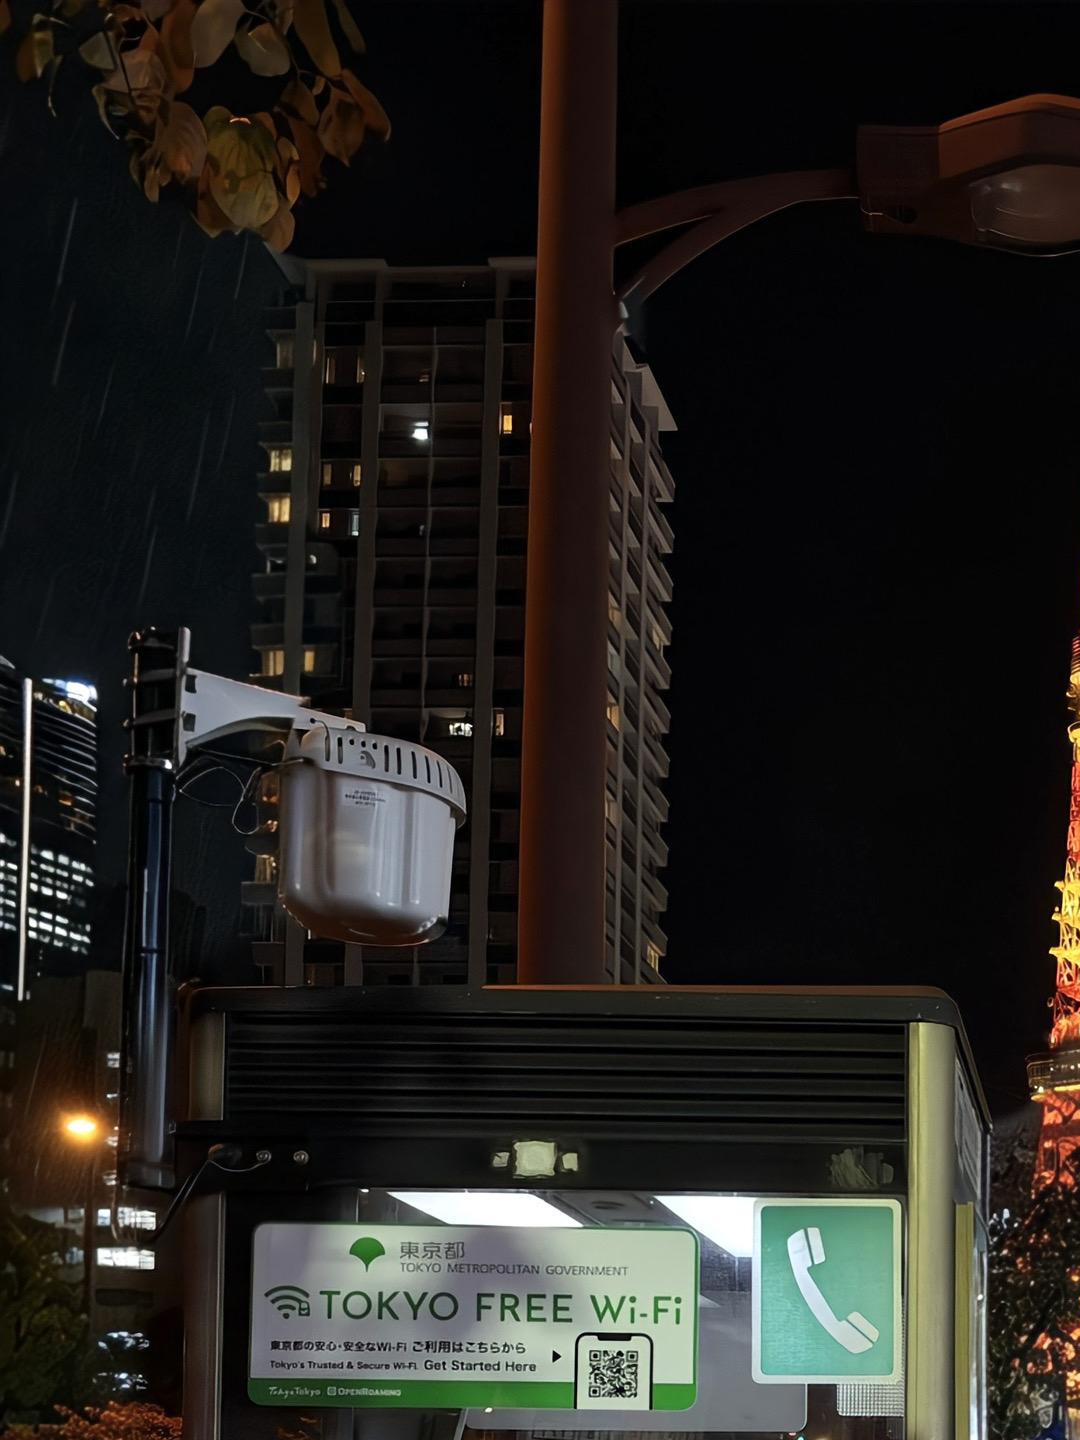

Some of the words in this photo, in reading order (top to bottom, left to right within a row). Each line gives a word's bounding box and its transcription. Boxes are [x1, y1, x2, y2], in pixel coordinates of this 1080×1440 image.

[400, 1241, 465, 1260] 東京都
[400, 1262, 442, 1273] TOKYO
[447, 1263, 540, 1275] METROPOLITAN
[545, 1265, 629, 1277] GOVERNMENT
[319, 1290, 459, 1321] TOKYO
[476, 1292, 573, 1323] FREE
[589, 1294, 683, 1325] Wi-Fi
[412, 1340, 527, 1354] ご利用はこちらから
[270, 1360, 305, 1370] Tokyo's
[308, 1361, 344, 1370] Trusted
[346, 1361, 354, 1370] &
[357, 1361, 390, 1370] Secure
[423, 1360, 447, 1371] Get
[451, 1360, 501, 1372] Started
[505, 1361, 537, 1372] Here
